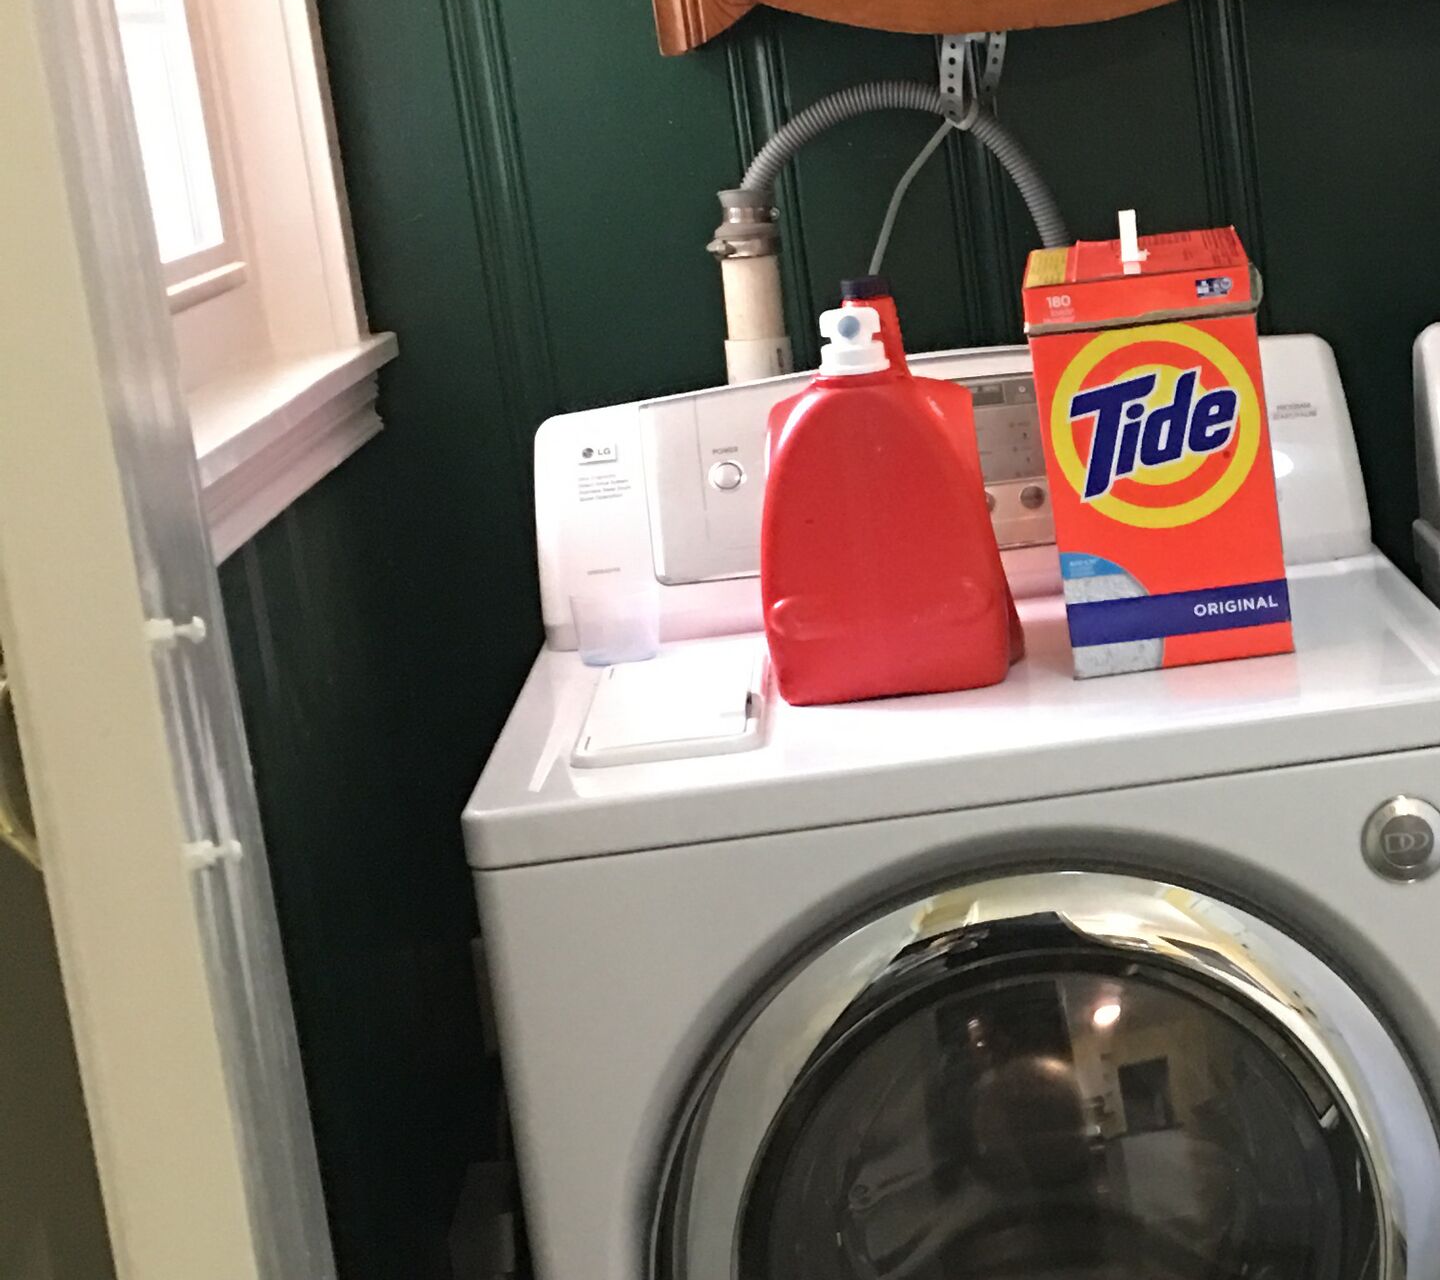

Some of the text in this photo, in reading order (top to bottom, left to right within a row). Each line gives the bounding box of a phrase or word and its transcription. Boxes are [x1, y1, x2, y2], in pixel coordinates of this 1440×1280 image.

[1046, 294, 1072, 309] 180
[1069, 368, 1238, 501] Tide
[1193, 595, 1279, 617] ORIGINAL
